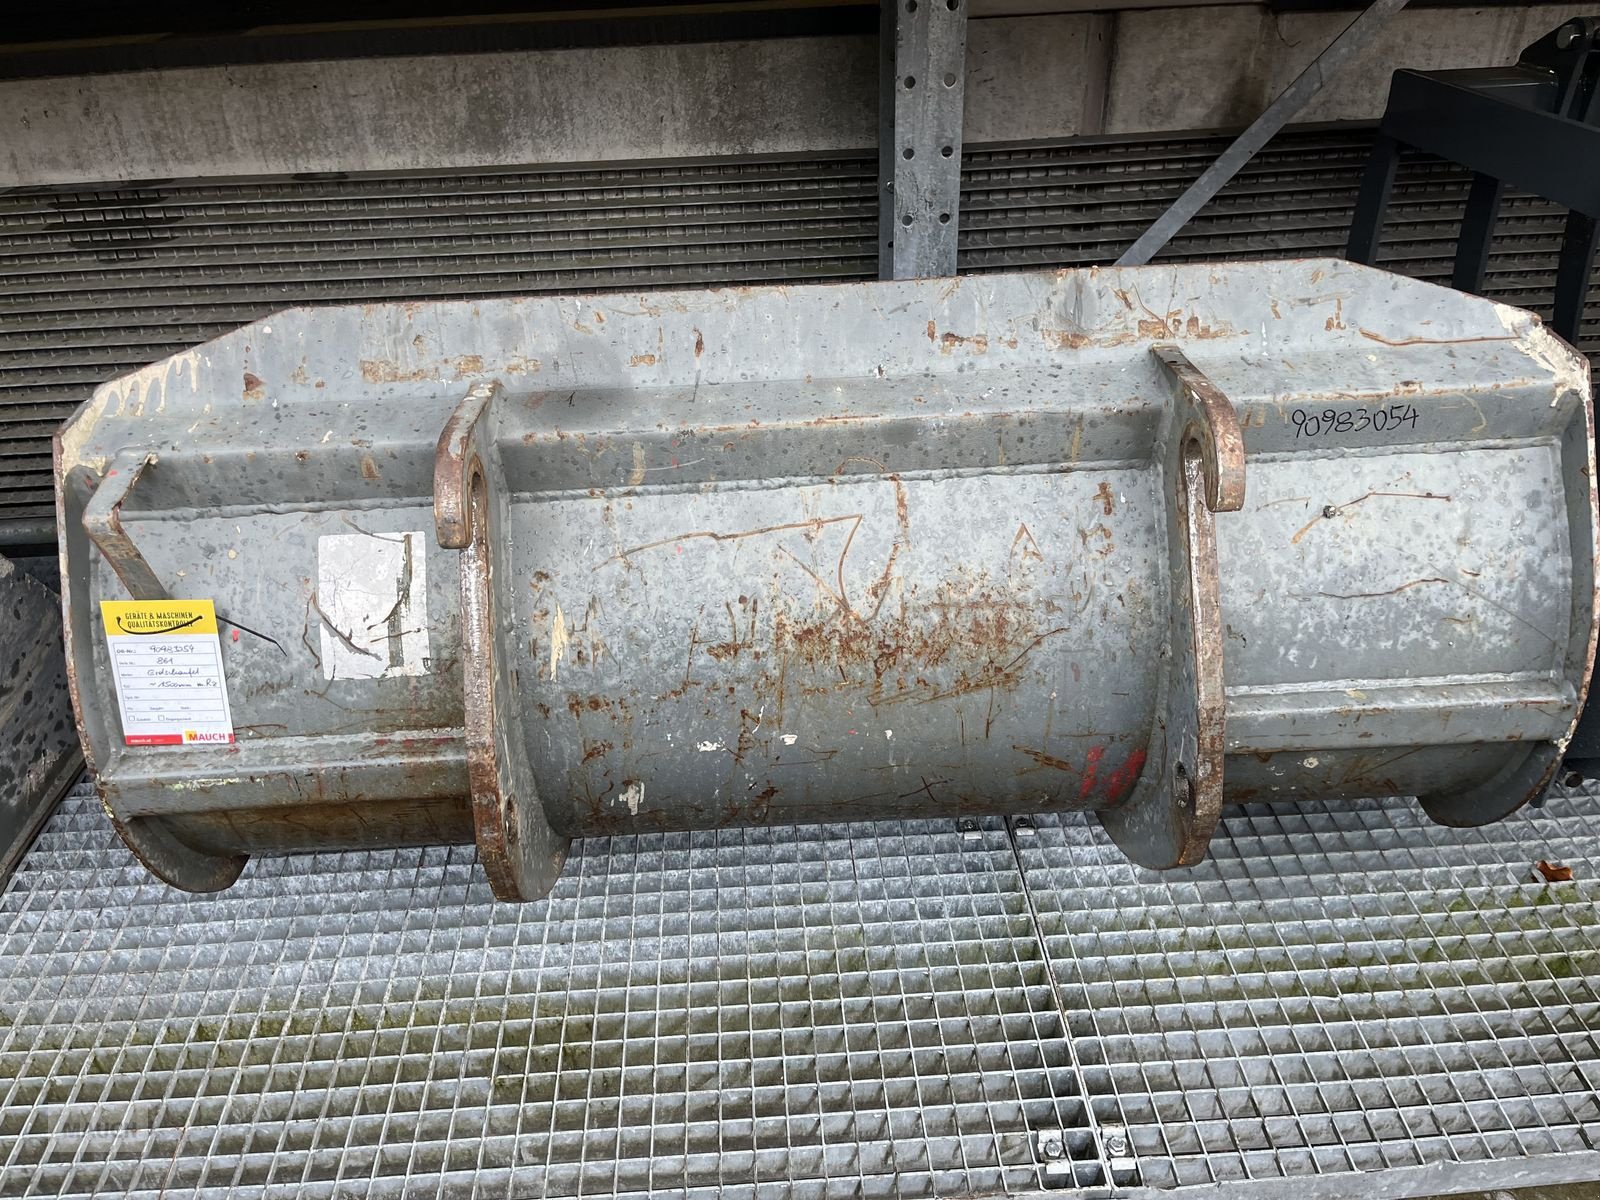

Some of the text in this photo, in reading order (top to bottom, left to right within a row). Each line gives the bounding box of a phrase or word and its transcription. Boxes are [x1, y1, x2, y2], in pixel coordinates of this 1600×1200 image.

[1291, 403, 1420, 439] 90983054
[156, 611, 194, 619] MASCHINEN
[127, 619, 194, 629] QUALITÄTSKONTRO
[188, 732, 226, 742] MAUCH
